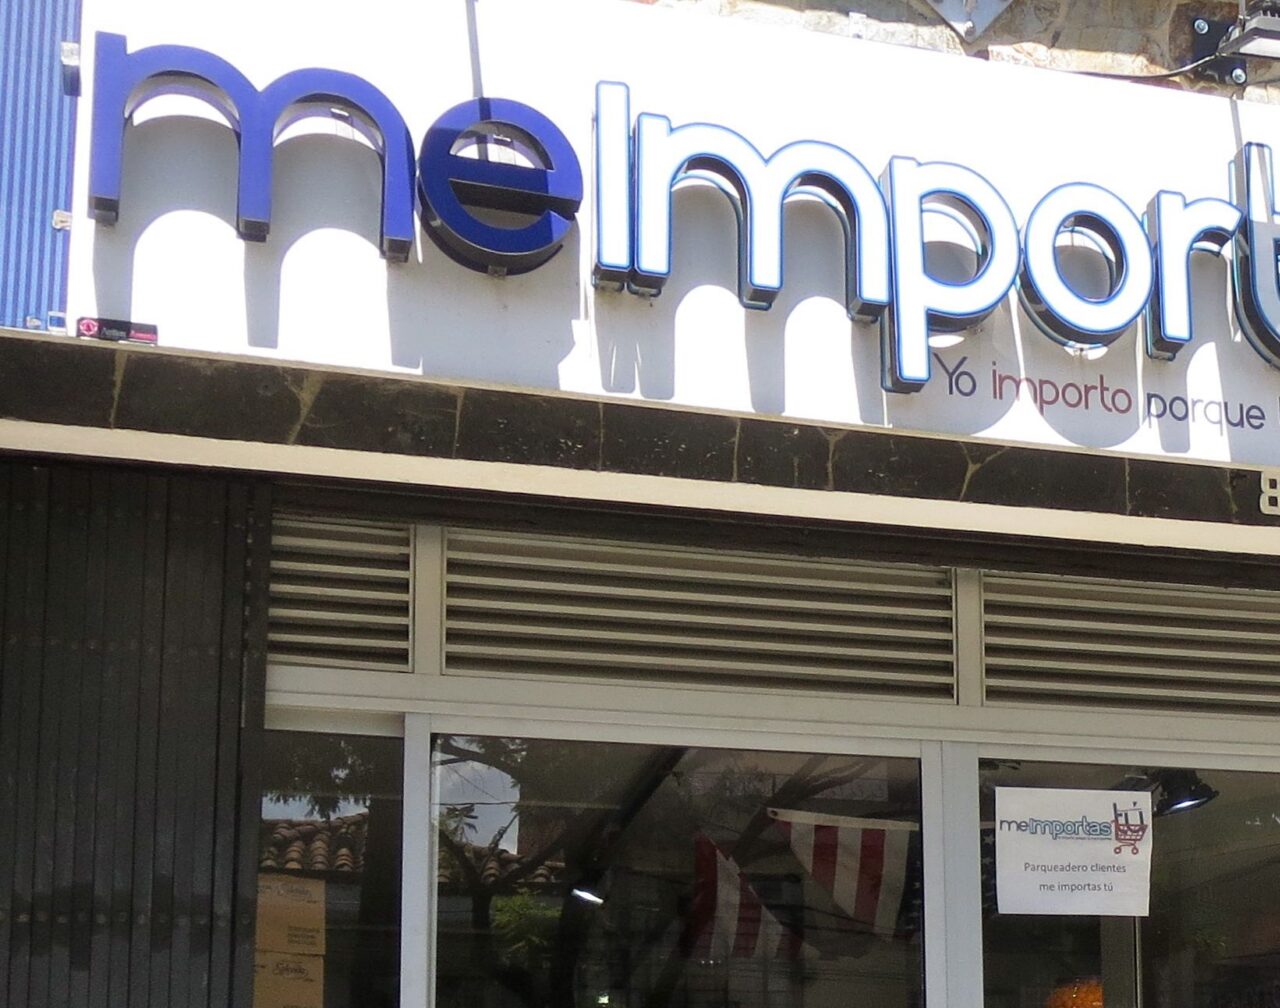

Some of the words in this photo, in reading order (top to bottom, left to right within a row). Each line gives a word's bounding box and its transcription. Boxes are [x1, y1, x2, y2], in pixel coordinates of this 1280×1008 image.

[932, 354, 978, 397] Yo
[991, 362, 1132, 416] importo
[1146, 389, 1267, 438] porque
[1024, 862, 1089, 873] Parqueadero
[1090, 862, 1127, 873] clientes
[1039, 884, 1055, 892] me
[1057, 882, 1102, 892] importas
[1103, 882, 1114, 892] tú
